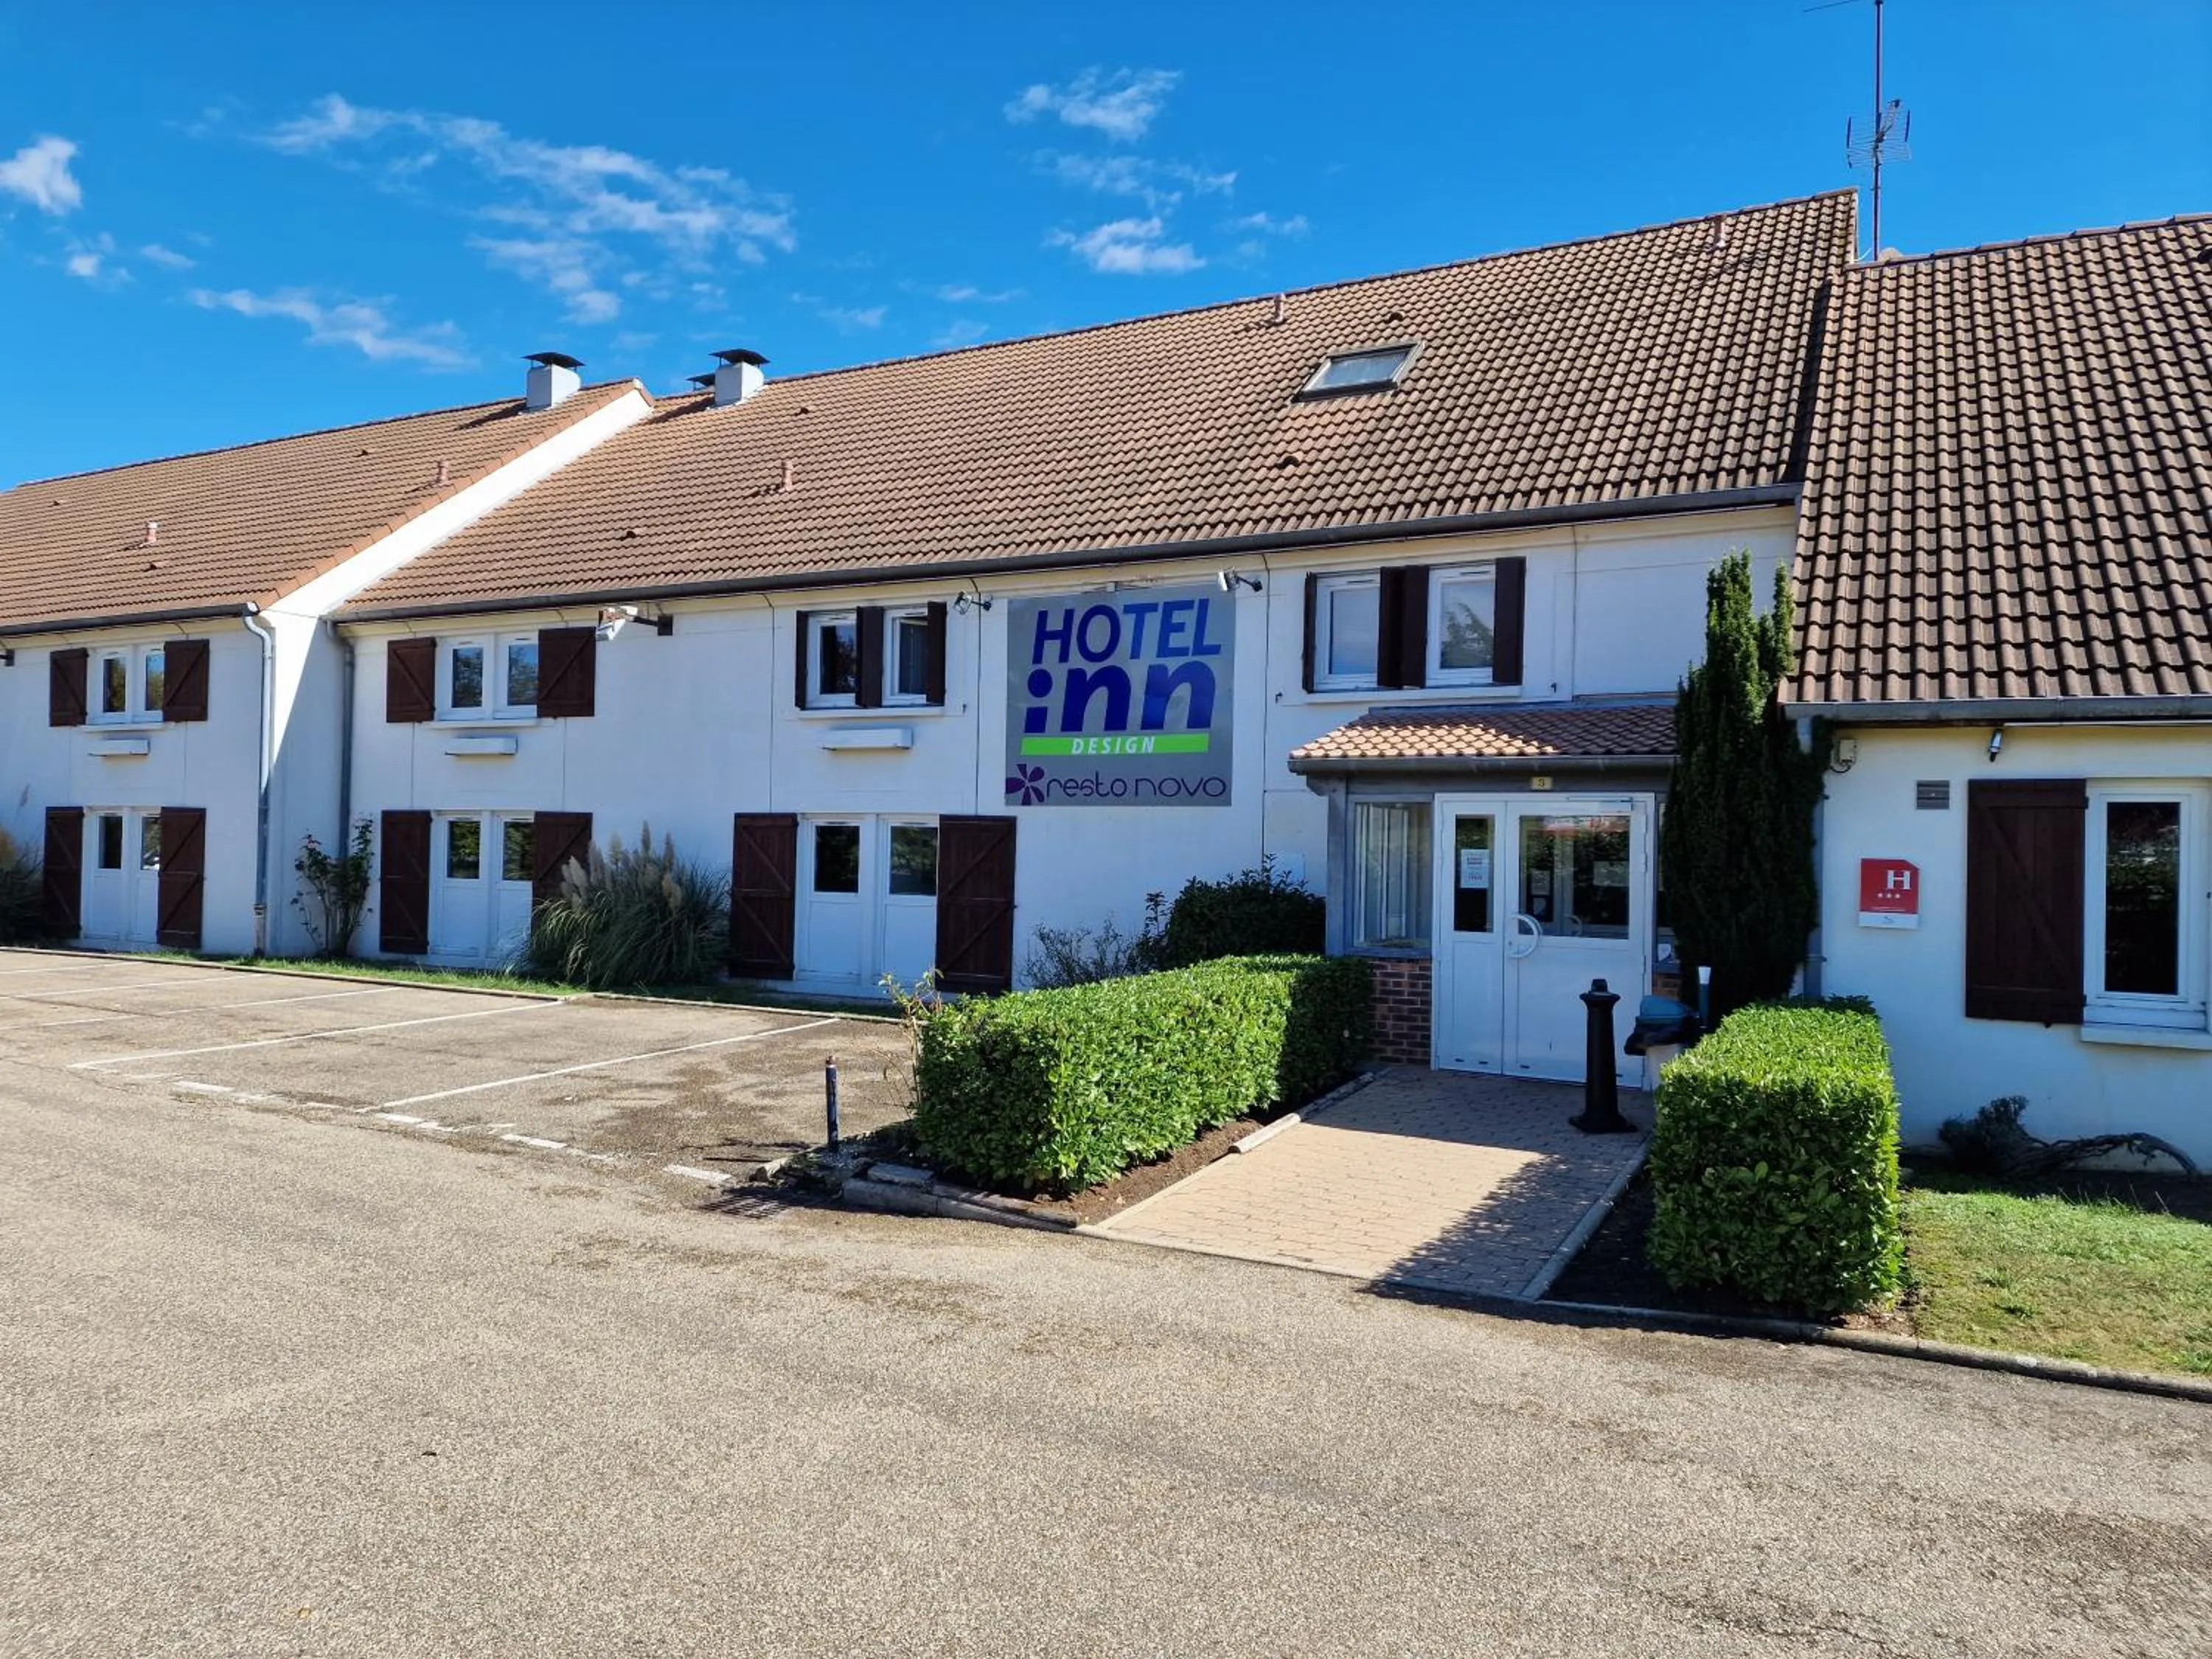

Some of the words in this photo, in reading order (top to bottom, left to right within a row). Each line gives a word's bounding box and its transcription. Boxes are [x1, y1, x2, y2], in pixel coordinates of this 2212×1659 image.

[1032, 598, 1221, 664] HOTEL
[1023, 661, 1215, 733] inn
[1071, 737, 1155, 755] DESIGN
[1046, 771, 1127, 797] resto
[1135, 776, 1226, 797] novo
[1538, 778, 1545, 788] 3
[1887, 870, 1910, 890] H
